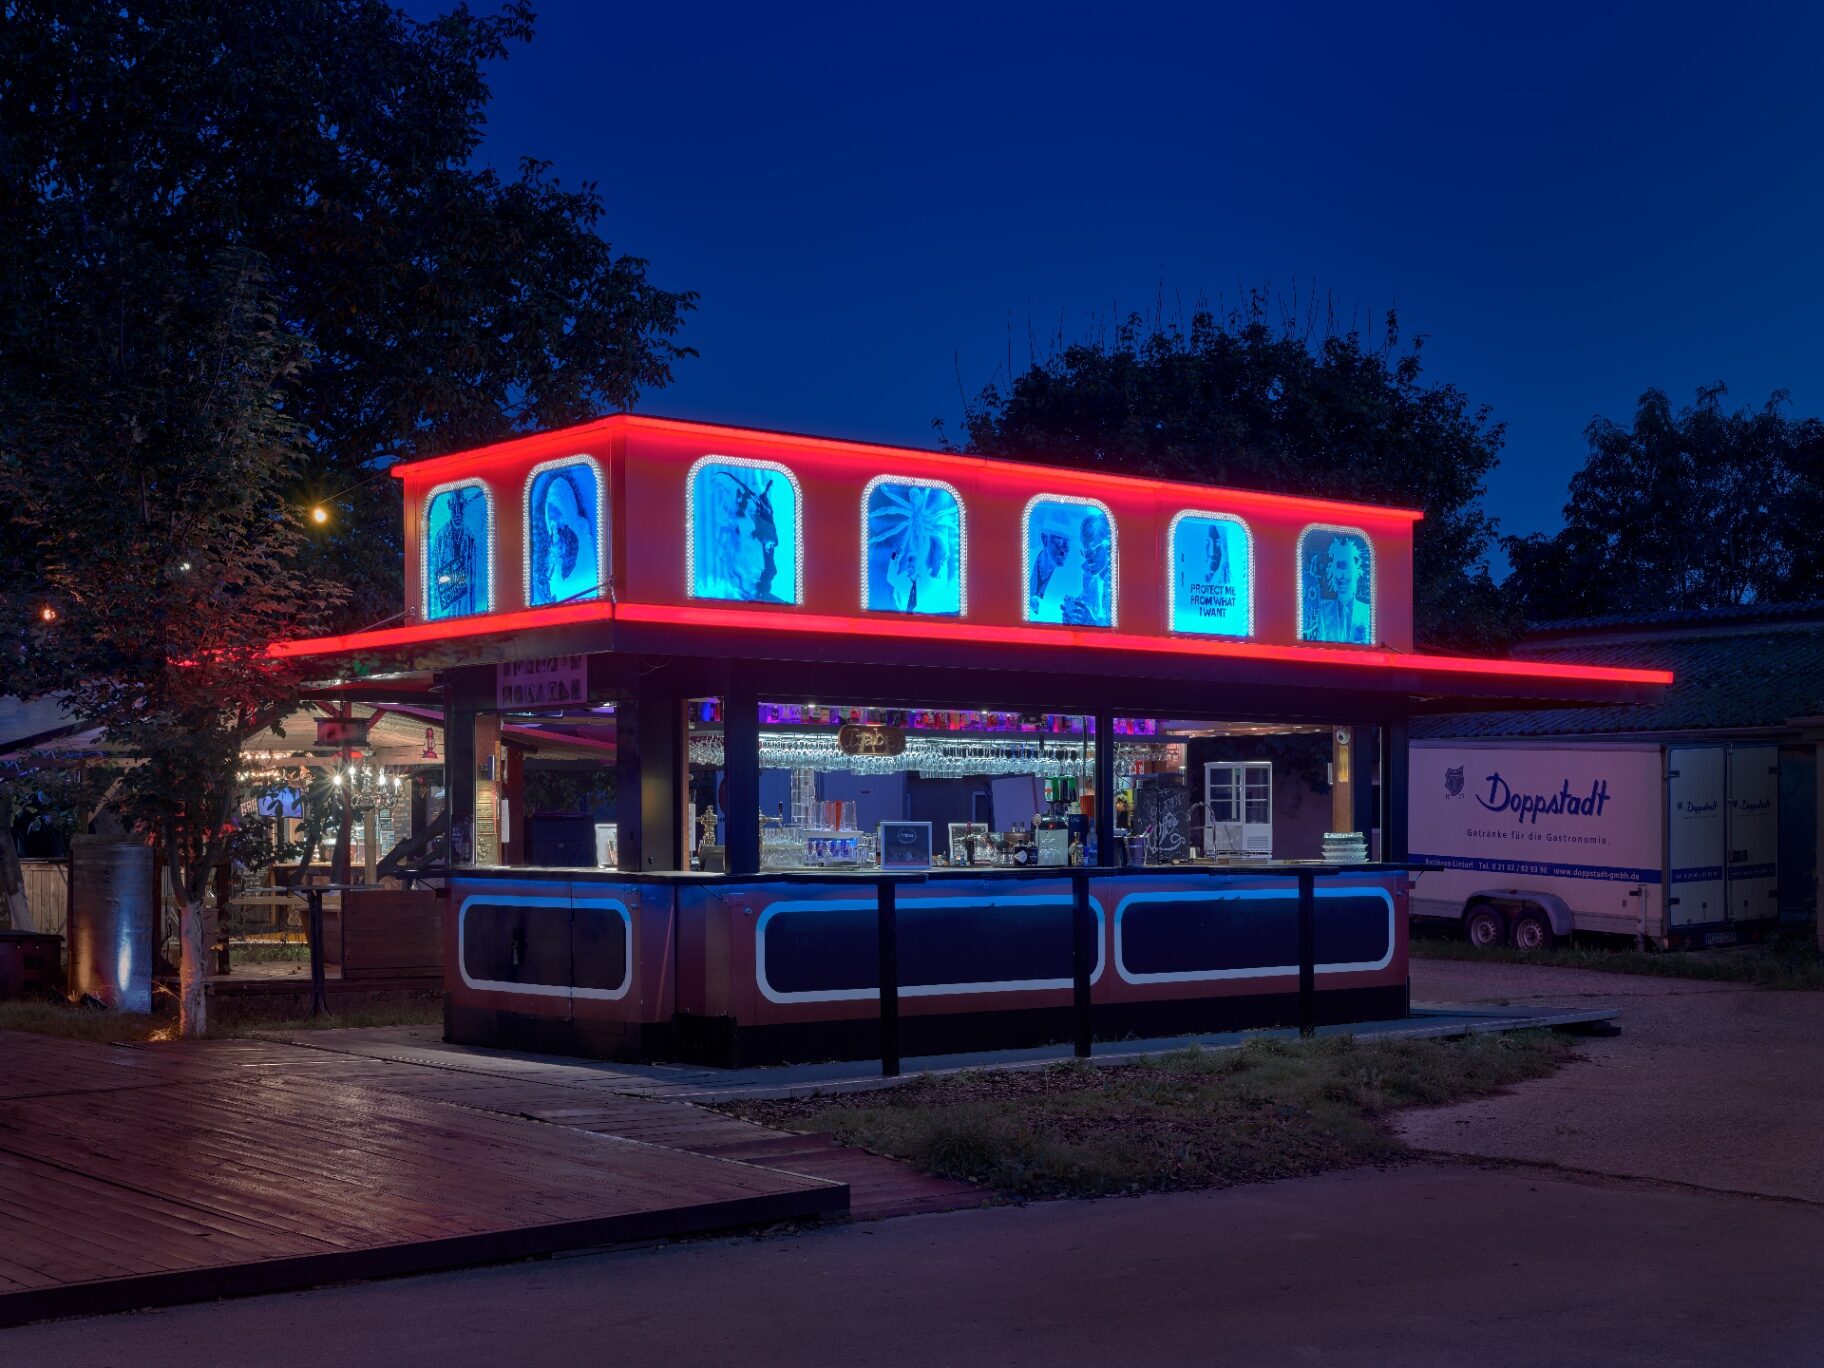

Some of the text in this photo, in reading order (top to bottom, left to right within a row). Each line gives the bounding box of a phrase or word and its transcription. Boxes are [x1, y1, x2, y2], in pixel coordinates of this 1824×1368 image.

[1190, 584, 1236, 596] PROTECT ME
[1190, 595, 1236, 607] FROM WHAT
[1203, 608, 1227, 618] WANT
[1475, 772, 1611, 824] Doppstadt
[1467, 829, 1507, 839] Getränke
[1511, 830, 1525, 840] für
[1528, 831, 1542, 841] die
[1478, 862, 1490, 870] Tel.
[1553, 868, 1640, 881] www.doppstadt-gmbh.de
